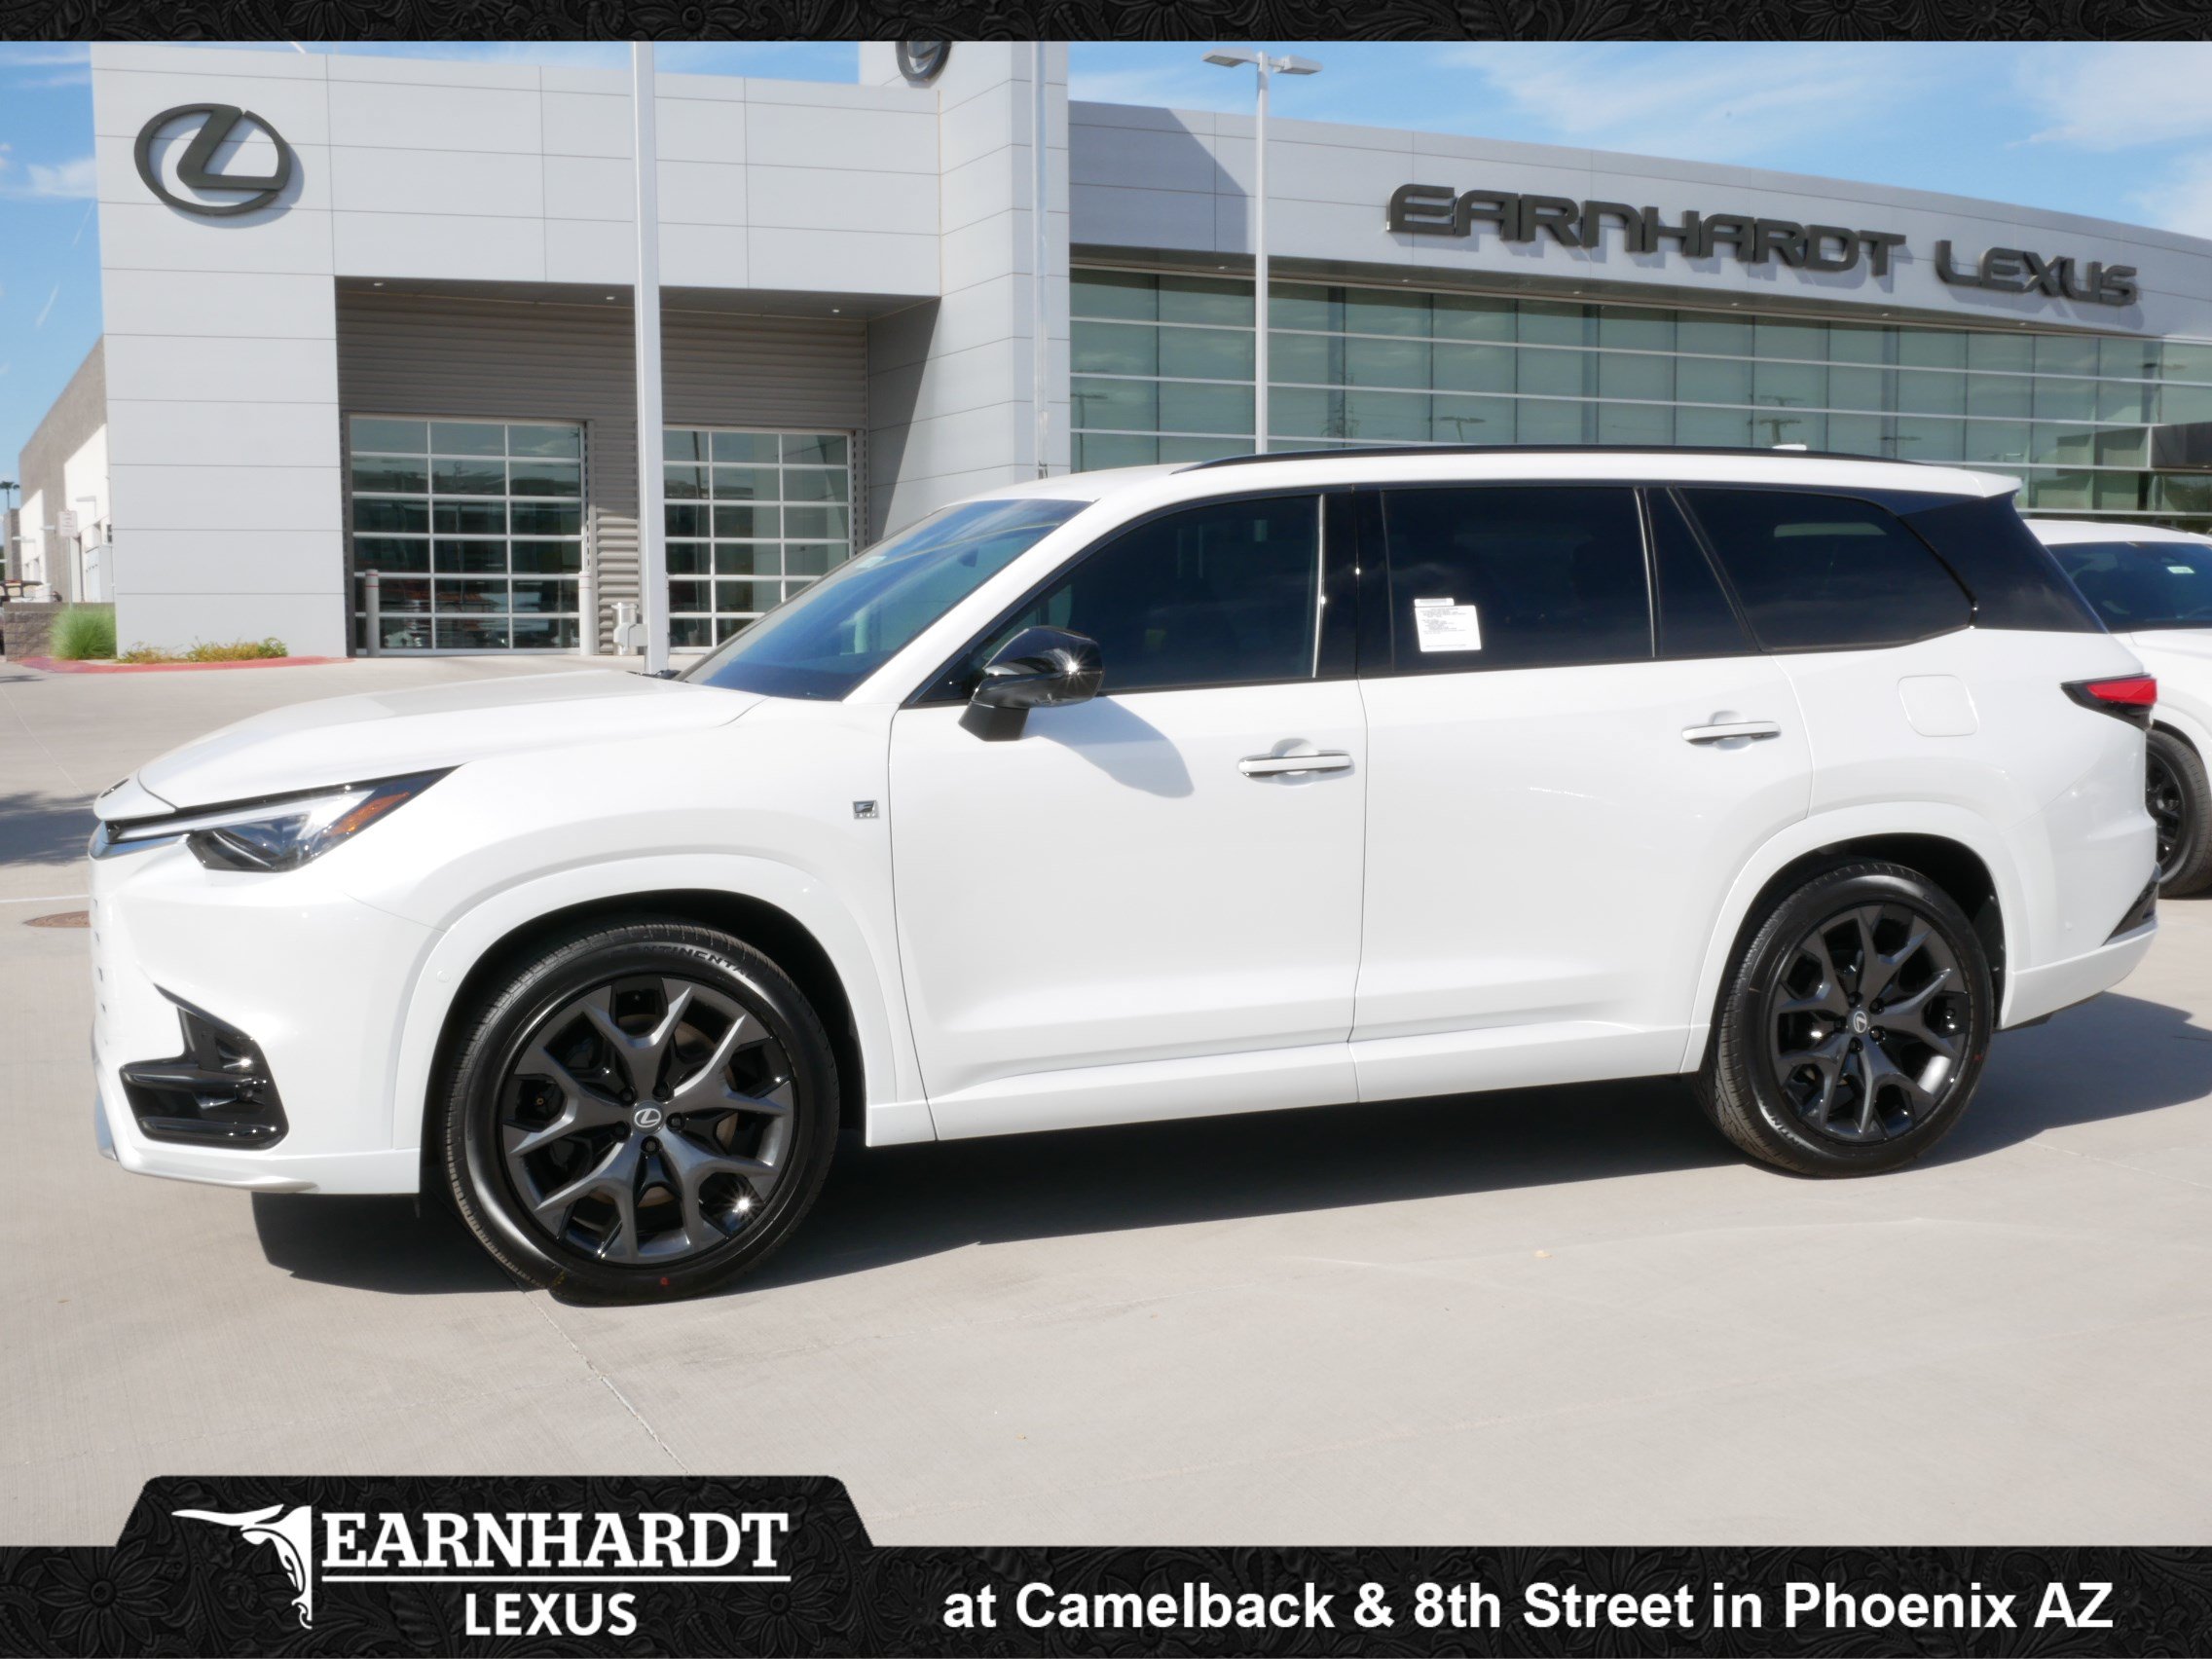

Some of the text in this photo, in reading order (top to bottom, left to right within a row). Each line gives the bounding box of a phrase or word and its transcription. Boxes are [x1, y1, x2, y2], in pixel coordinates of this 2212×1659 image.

[1386, 182, 2138, 308] EARNHARDT LEXUS
[613, 944, 750, 977] NTINENTA
